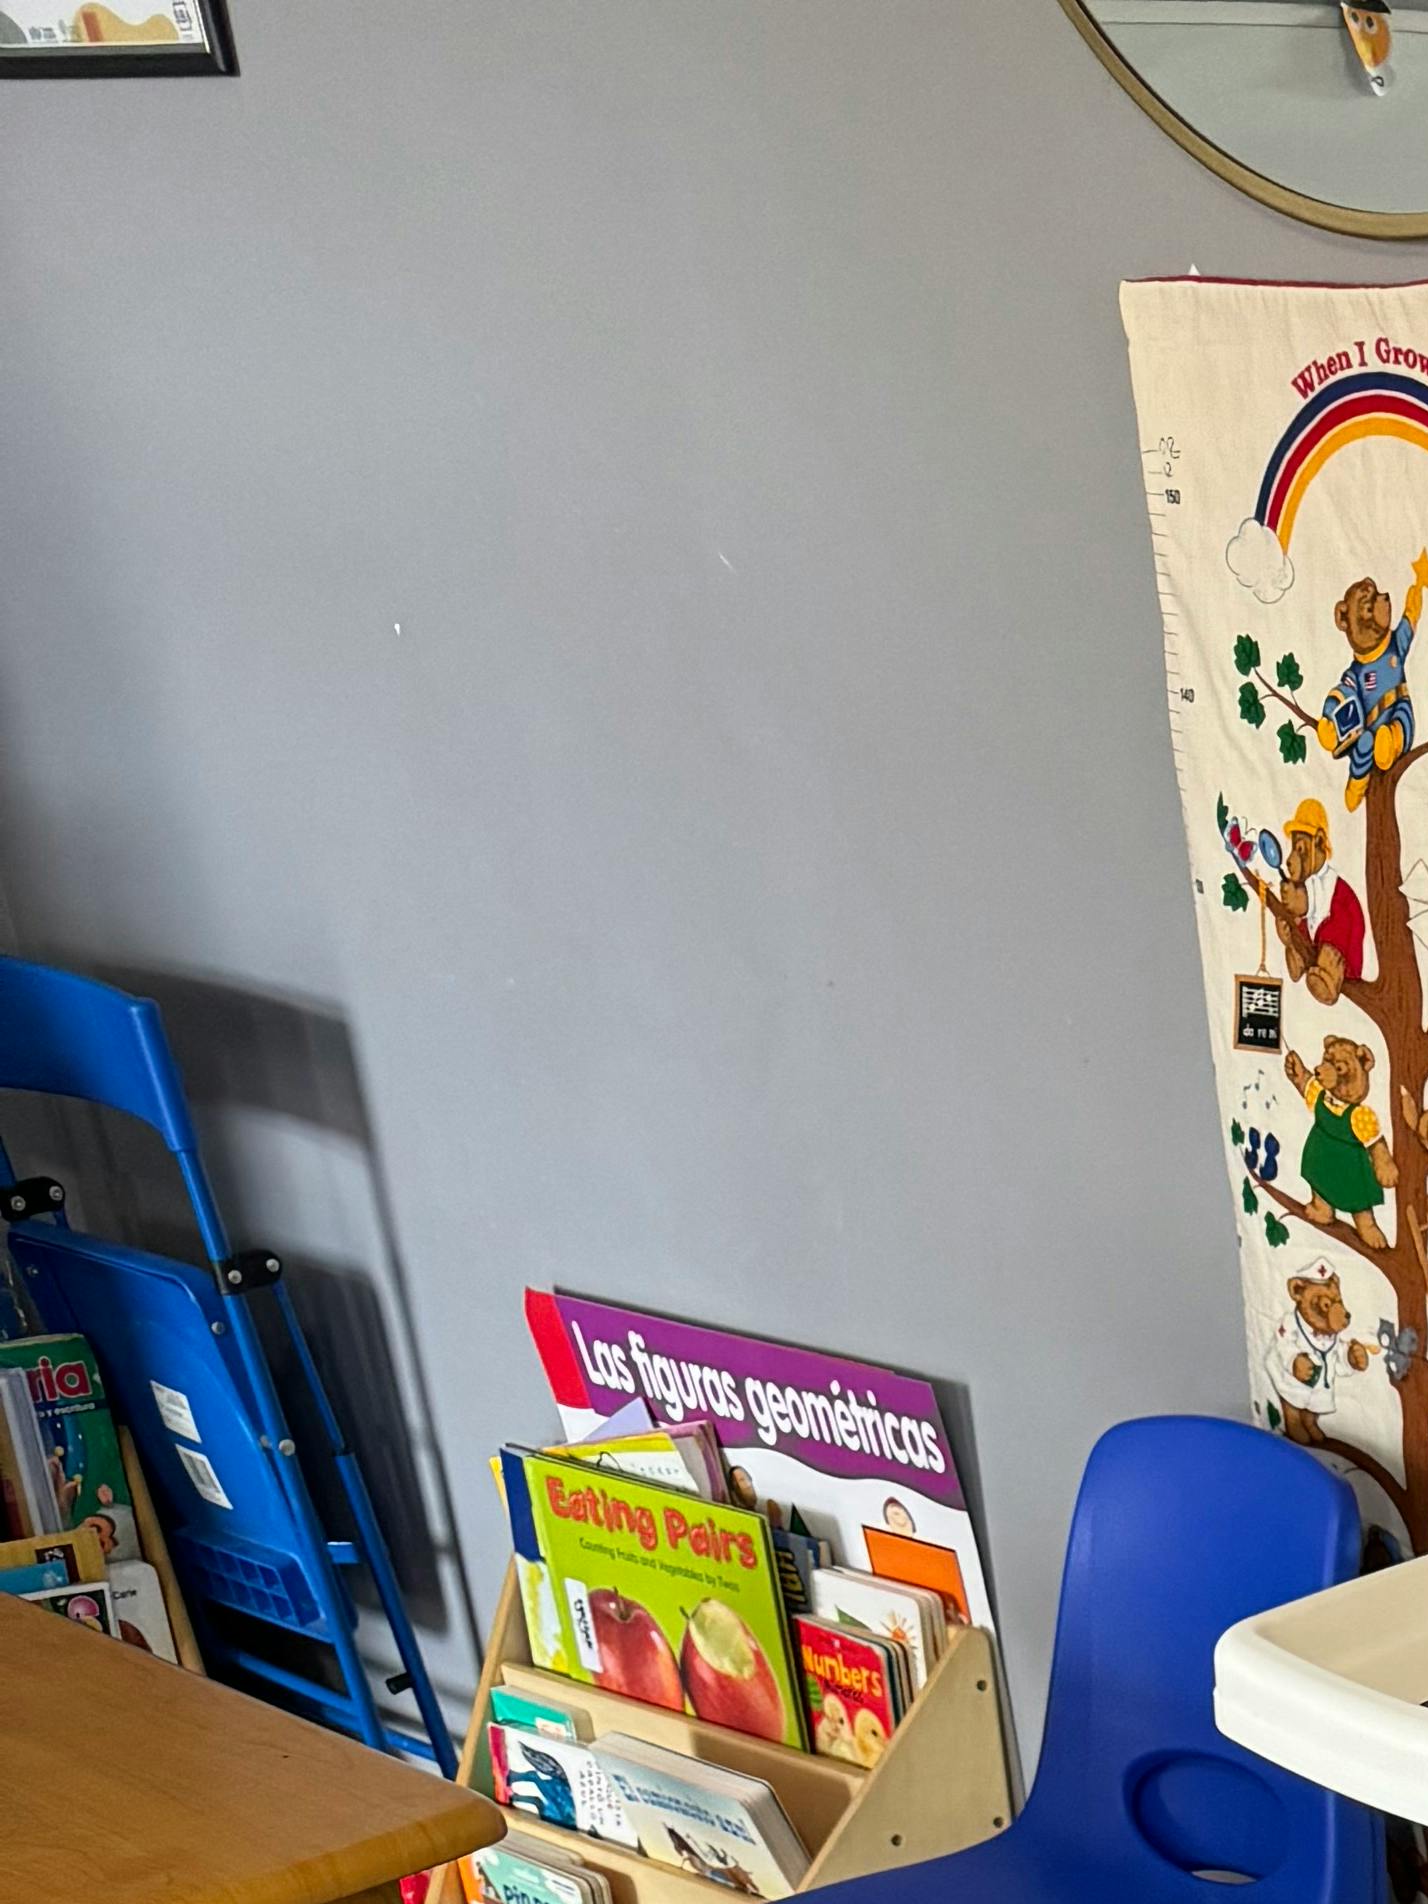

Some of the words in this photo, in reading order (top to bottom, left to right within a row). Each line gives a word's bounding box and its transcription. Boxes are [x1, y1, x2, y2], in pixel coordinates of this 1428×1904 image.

[1291, 350, 1353, 401] When
[1353, 340, 1369, 368] I
[1165, 488, 1181, 504] 150
[1179, 688, 1195, 703] 140
[571, 1320, 635, 1393] Las
[628, 1330, 745, 1422] figuras
[745, 1377, 946, 1474] geométricas
[545, 1475, 658, 1551] Eating
[663, 1507, 758, 1569] Pairs
[802, 1644, 883, 1697] Numbers
